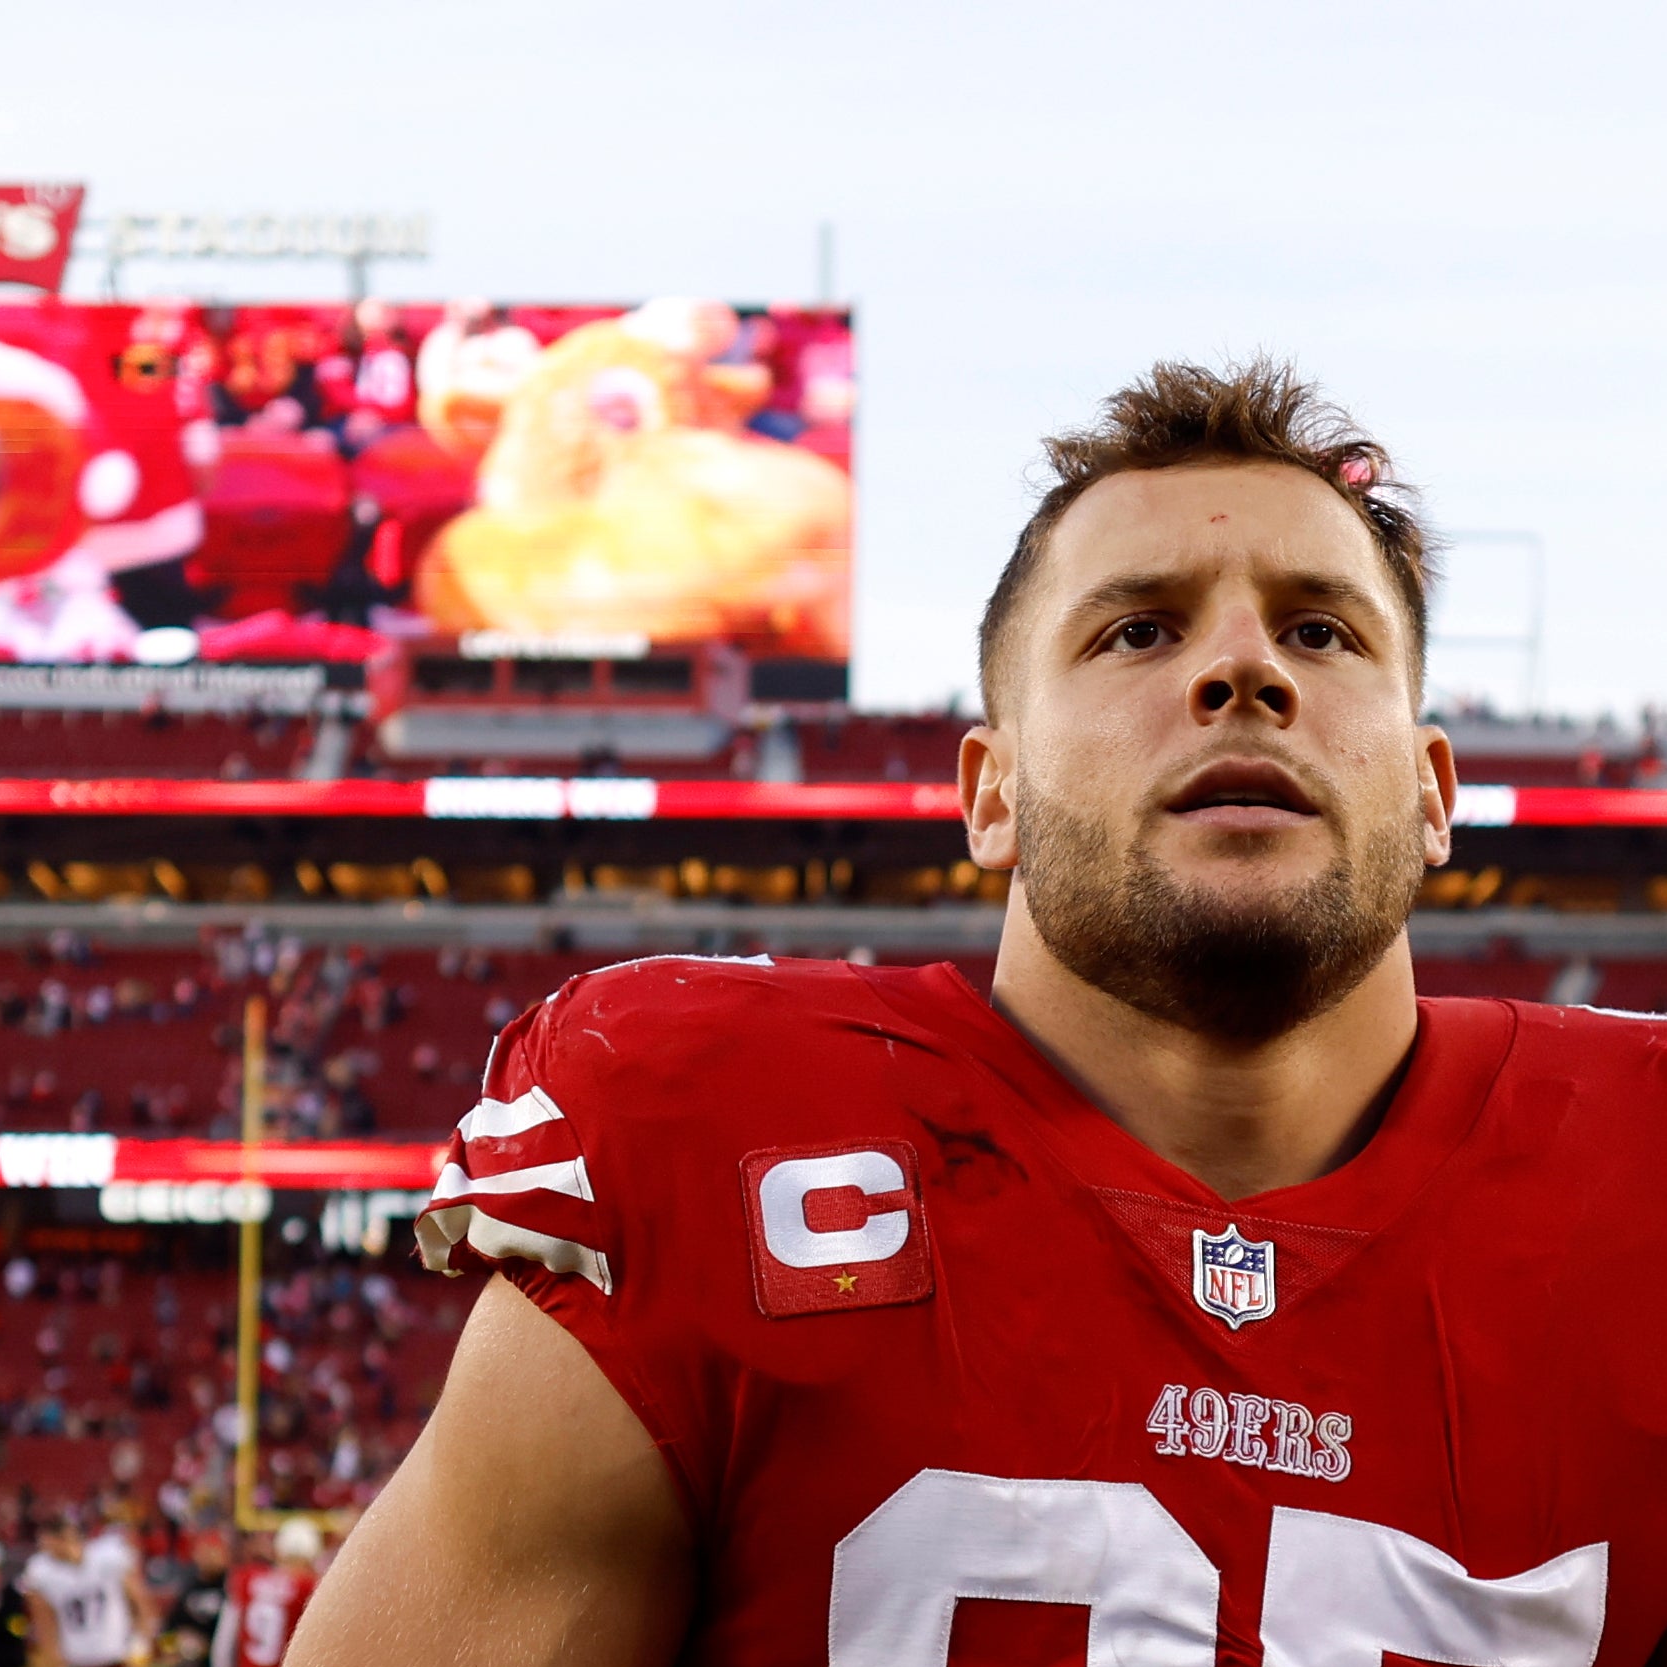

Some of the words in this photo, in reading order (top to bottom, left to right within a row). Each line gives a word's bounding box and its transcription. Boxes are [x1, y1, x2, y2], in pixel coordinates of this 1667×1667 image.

[759, 1151, 910, 1268] C
[1207, 1267, 1264, 1310] NFL
[1146, 1383, 1353, 1482] 49ERS
